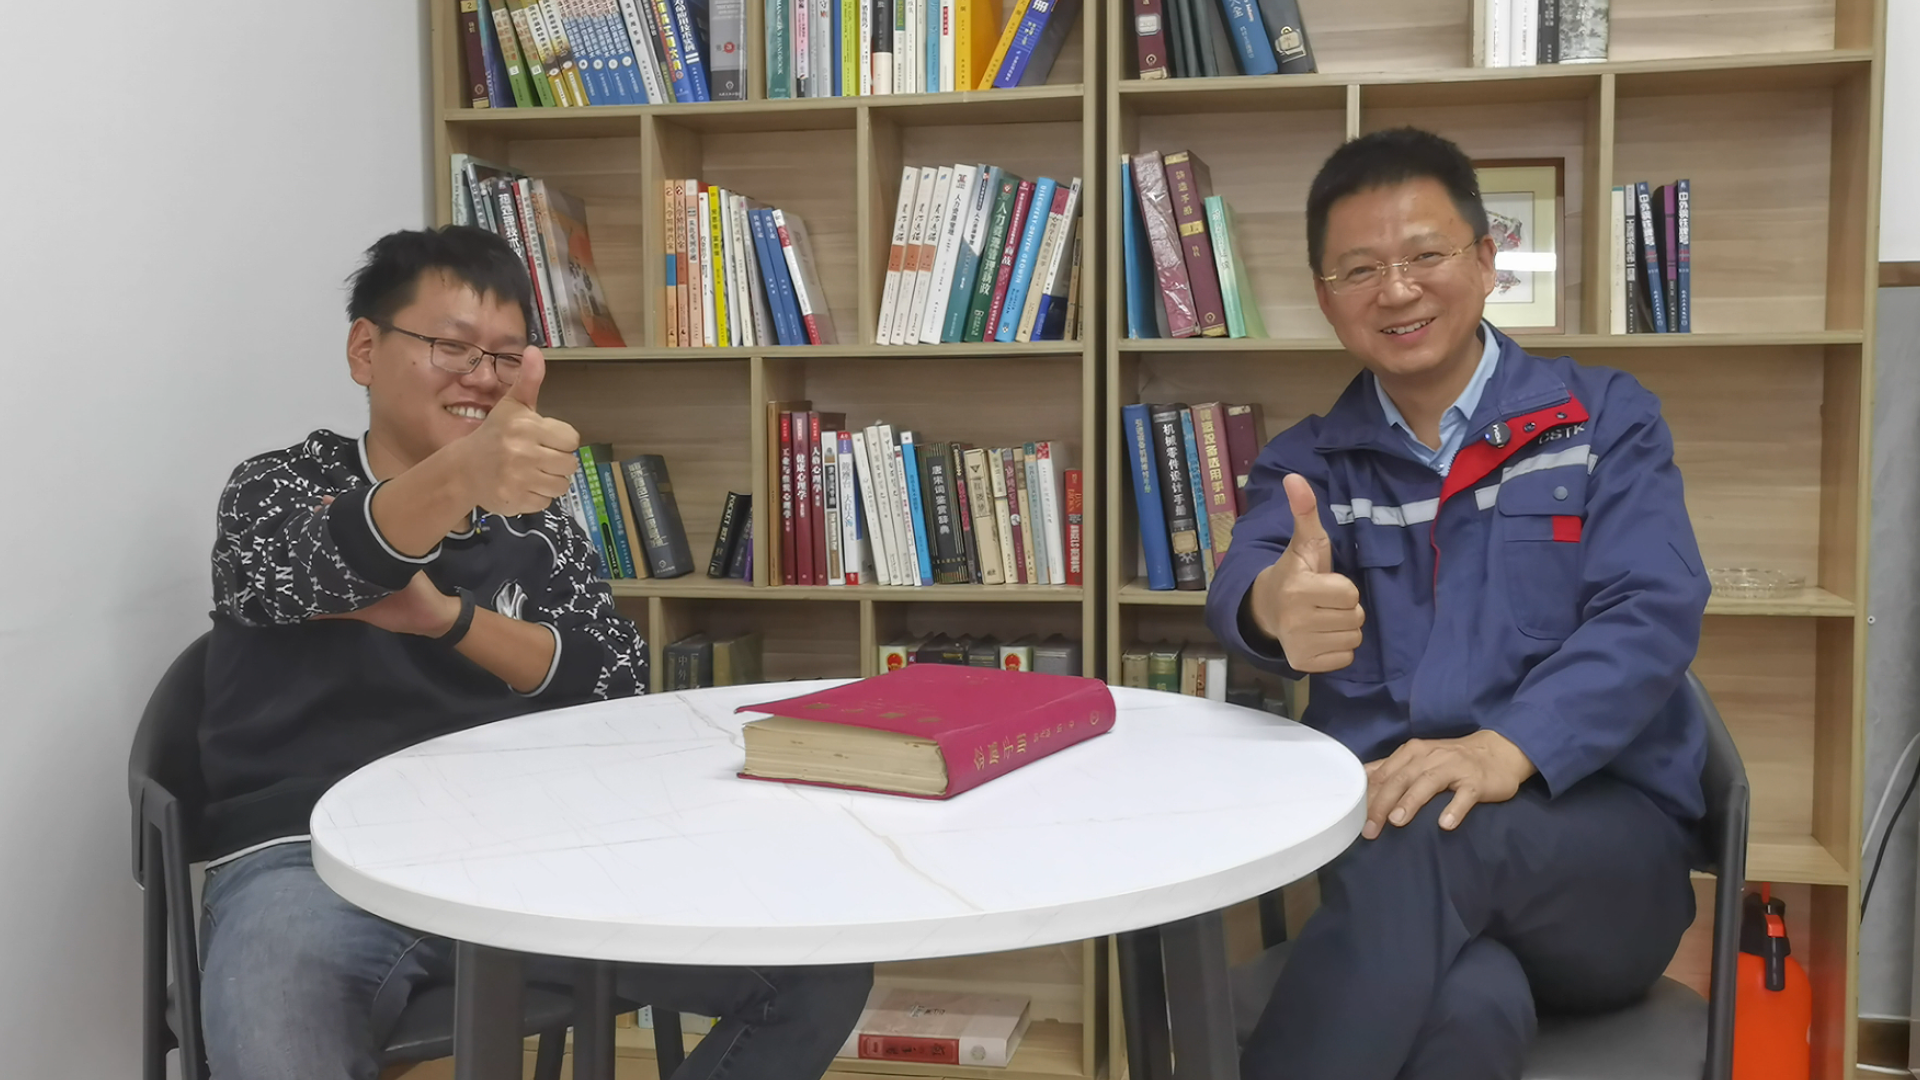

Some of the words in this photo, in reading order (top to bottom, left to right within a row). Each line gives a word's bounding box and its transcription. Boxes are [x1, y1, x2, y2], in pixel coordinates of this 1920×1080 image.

[795, 453, 808, 501] 健康心理学
[931, 465, 950, 535] 唐宋词鉴赏辞典
